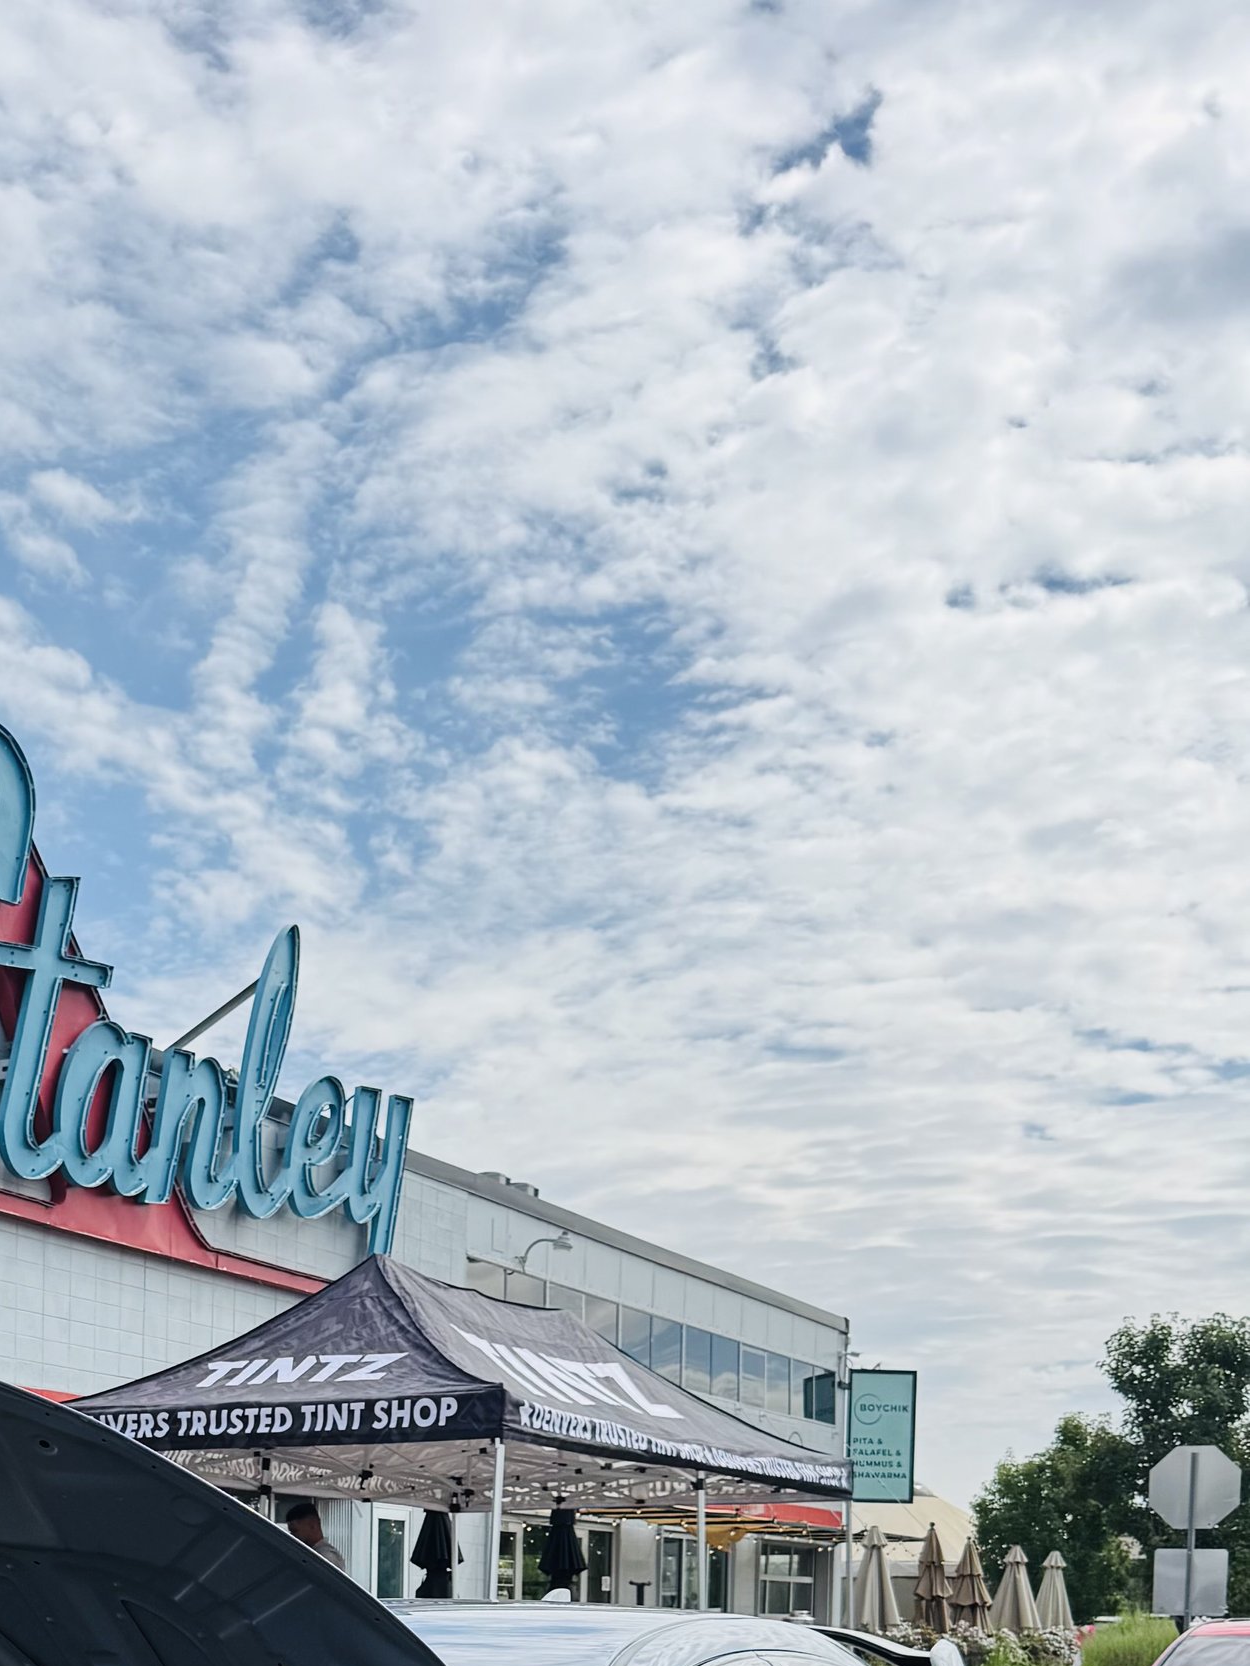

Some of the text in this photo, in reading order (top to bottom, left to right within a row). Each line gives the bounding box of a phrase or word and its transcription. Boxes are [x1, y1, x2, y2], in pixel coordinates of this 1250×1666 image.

[195, 1352, 409, 1388] TINTZ
[177, 1404, 294, 1436] TRUSTED
[301, 1402, 366, 1431] TINT
[372, 1397, 458, 1429] SHOP
[532, 1404, 592, 1440] DENVERS
[860, 1404, 909, 1412] BOYCHIK
